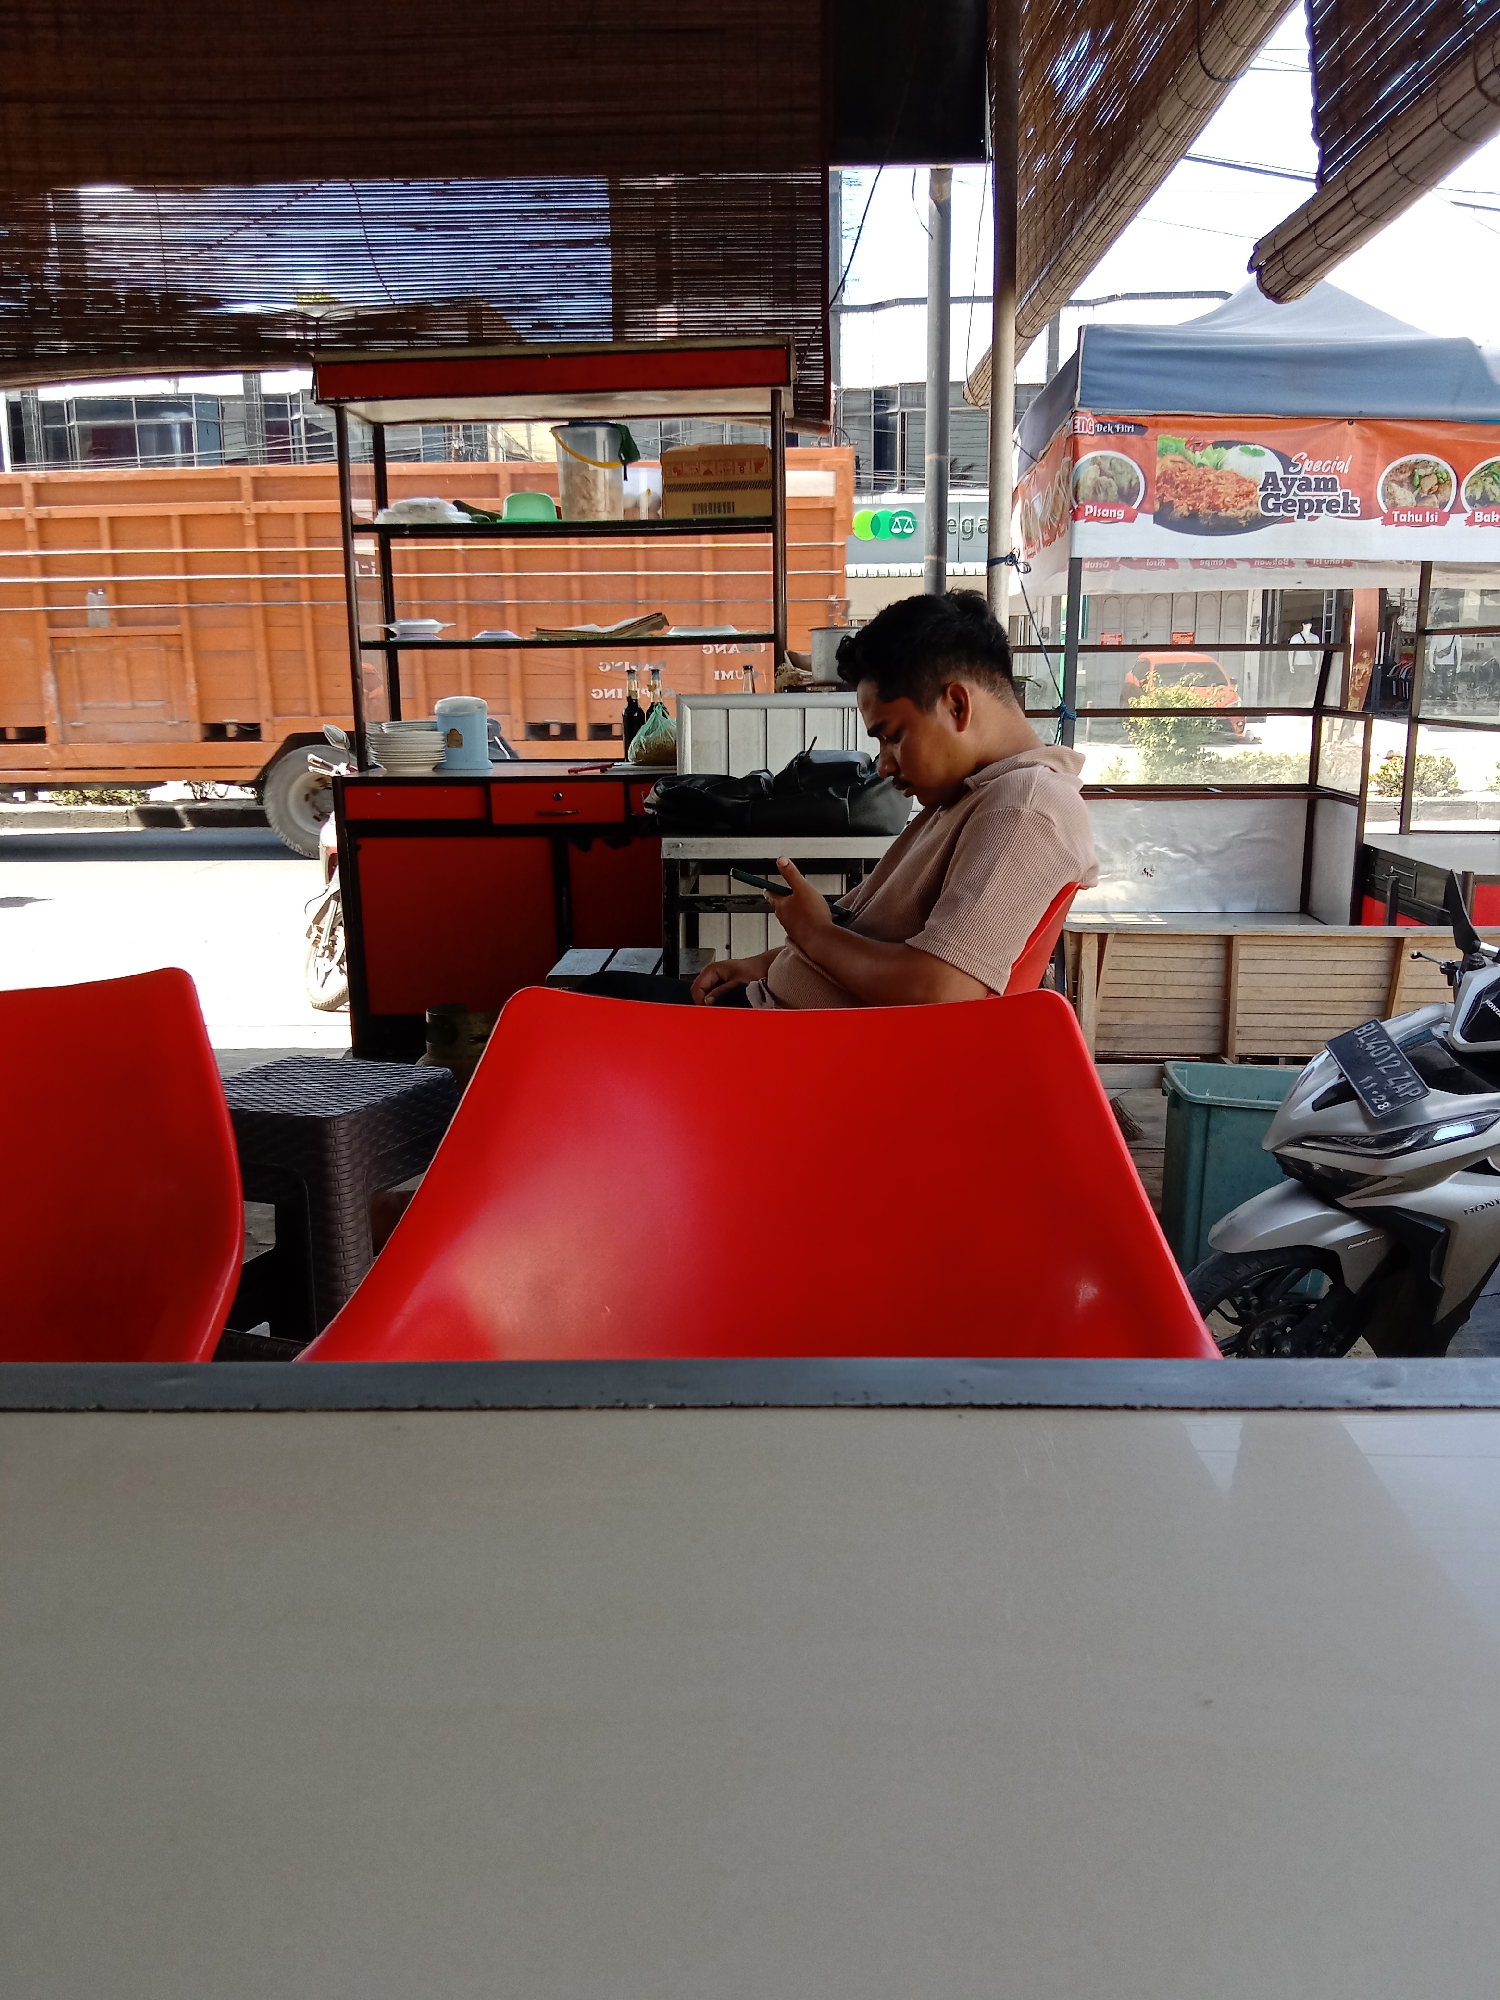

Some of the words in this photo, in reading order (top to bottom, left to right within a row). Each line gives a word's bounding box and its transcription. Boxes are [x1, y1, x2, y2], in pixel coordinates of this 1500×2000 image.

[1289, 452, 1352, 475] Special
[1259, 471, 1339, 498] Ayam
[1084, 504, 1125, 519] Pisang
[1260, 491, 1359, 519] Geprek
[1392, 511, 1422, 523] Tahu
[1425, 511, 1438, 523] Isi
[1354, 1023, 1380, 1044] BL
[1387, 1071, 1422, 1098] ZAP
